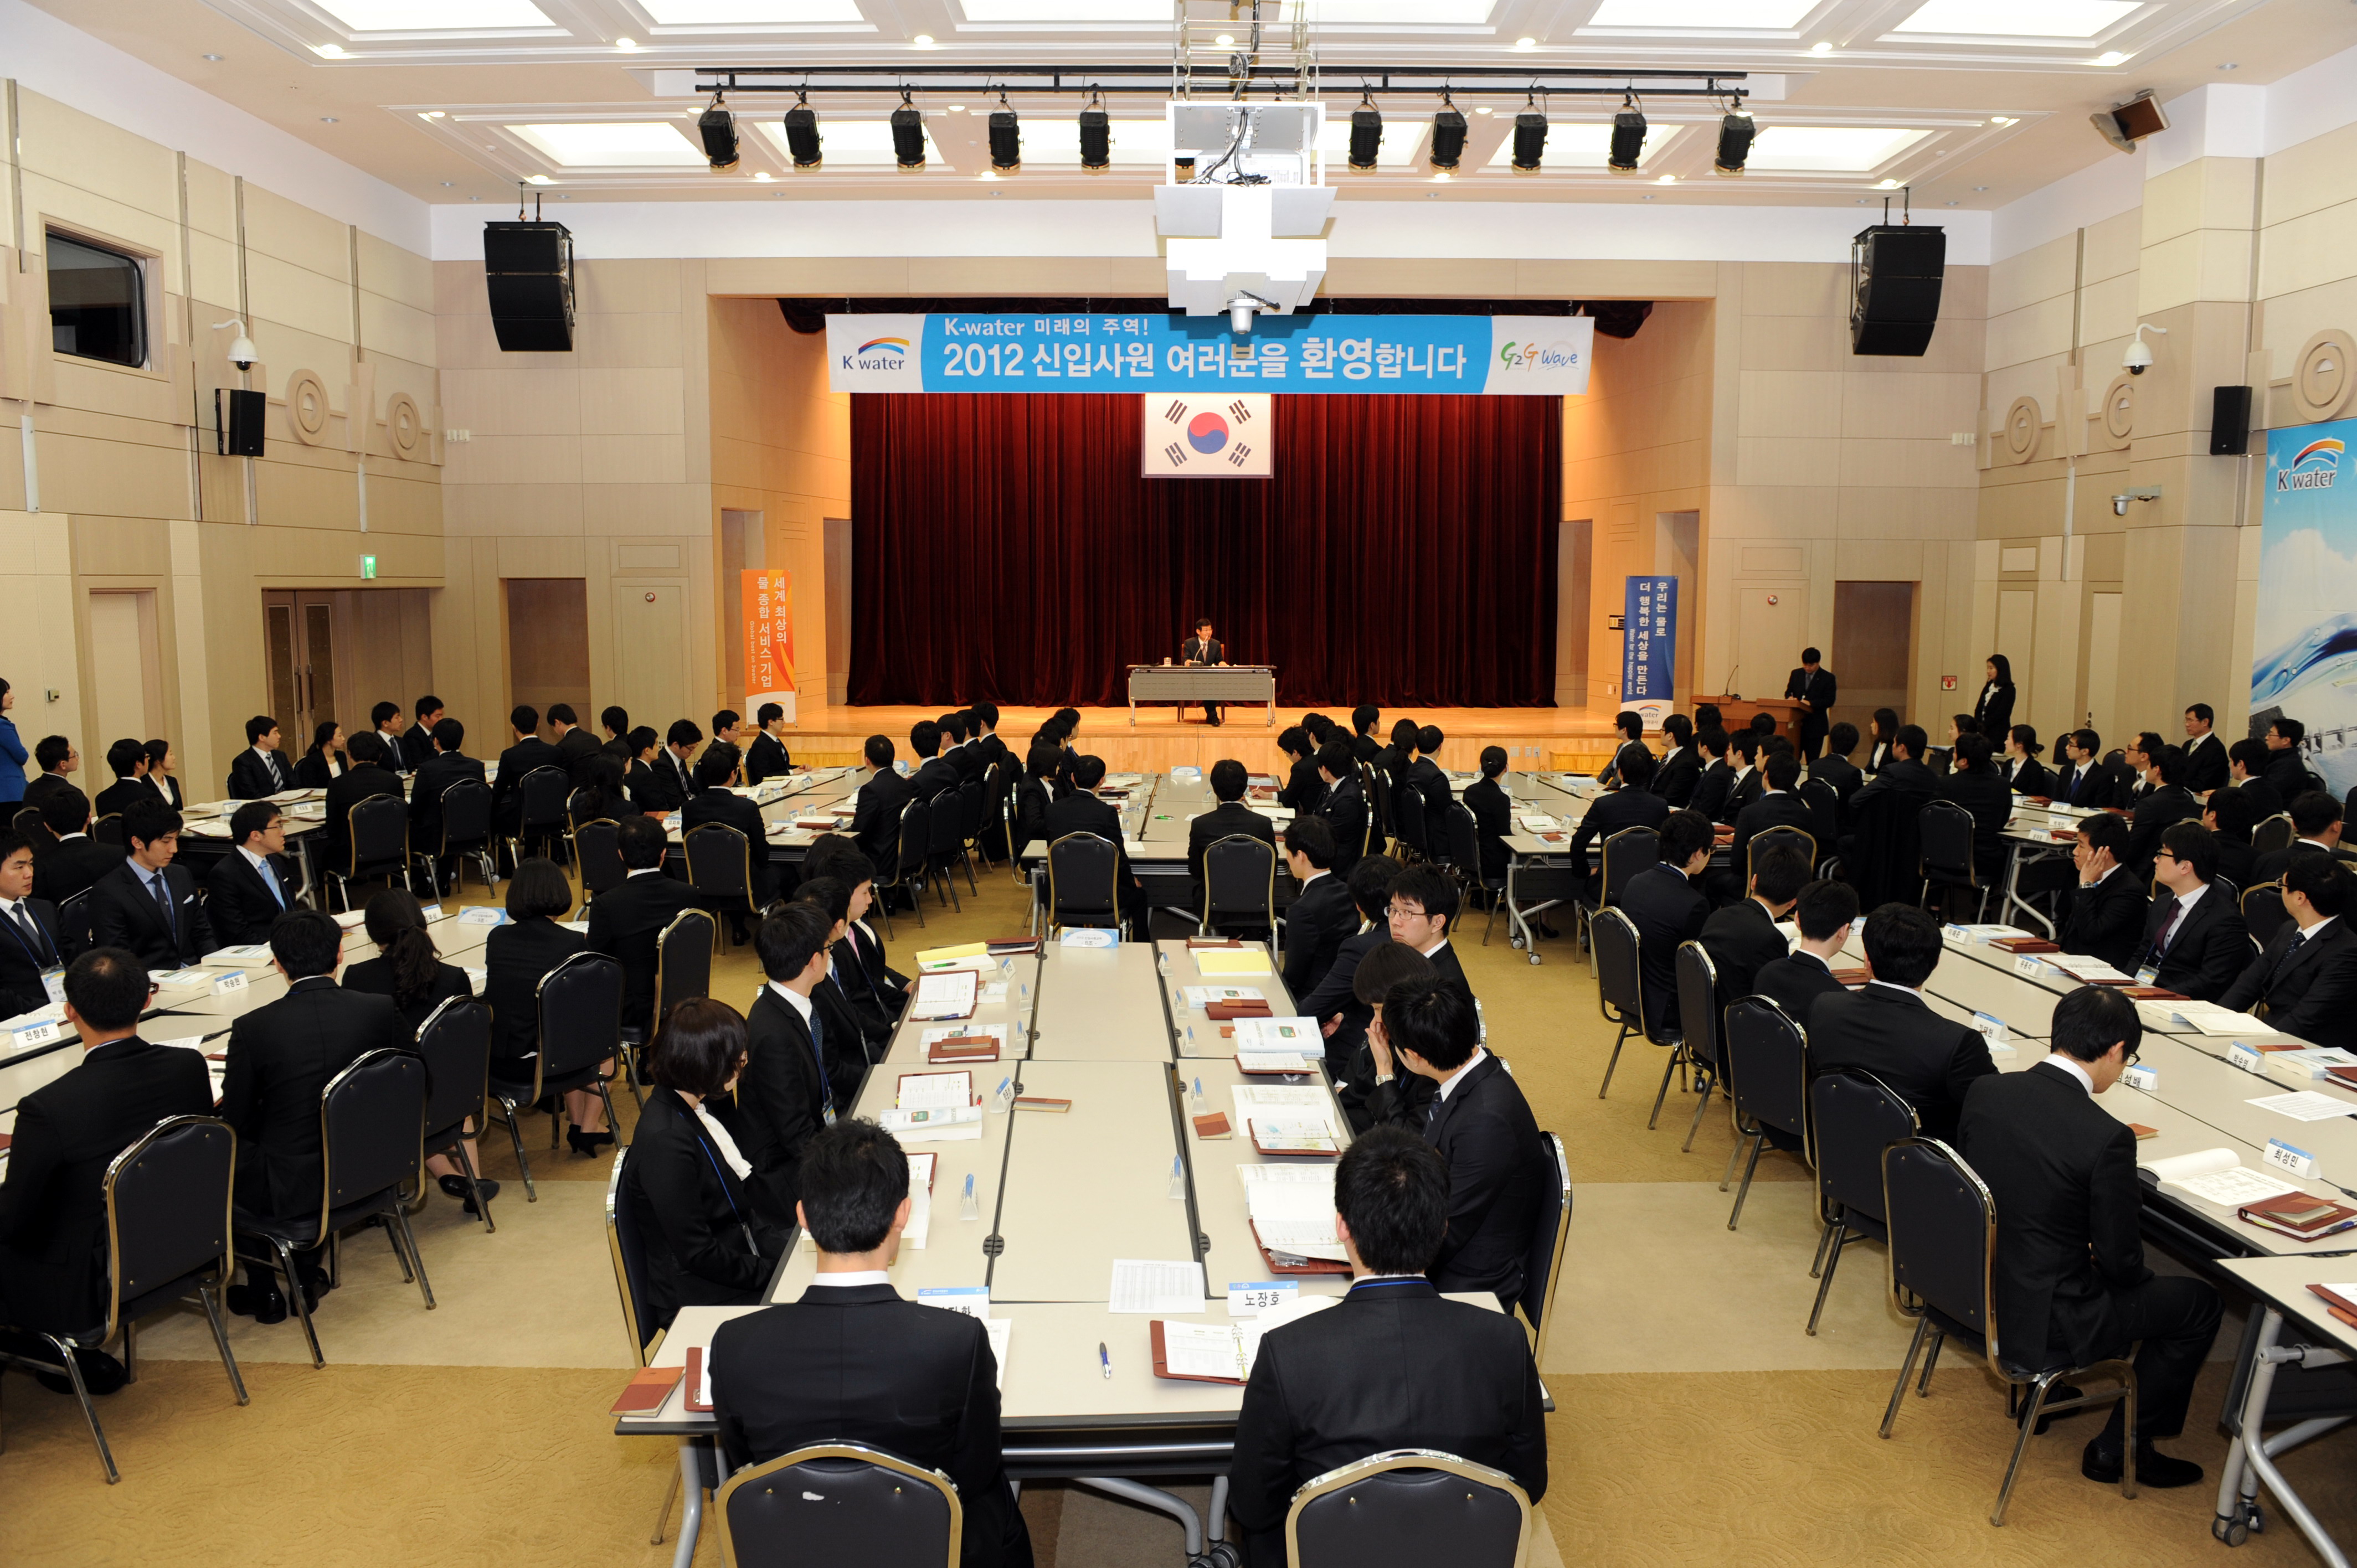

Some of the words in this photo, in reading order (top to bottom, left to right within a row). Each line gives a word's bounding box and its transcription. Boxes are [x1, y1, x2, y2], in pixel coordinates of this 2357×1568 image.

[944, 318, 1025, 336] K-water
[1035, 318, 1090, 336] 미래의
[1102, 318, 1149, 336] 주역!
[858, 357, 904, 370] water
[943, 342, 1025, 376] 2012
[1032, 342, 1154, 378] 신입사원
[1167, 341, 1289, 378] 여러분을
[1300, 337, 1466, 380] 환영합니다
[2292, 467, 2336, 489] water
[757, 576, 769, 590] 물
[774, 576, 786, 602] 세계
[1639, 582, 1650, 592] 더
[758, 593, 770, 619] 종합
[1656, 582, 1668, 613] 우리는
[775, 605, 787, 643] 최상의
[1639, 596, 1650, 627] 행복한
[1655, 616, 1667, 637] 물로
[759, 622, 771, 658] 서비스
[1637, 630, 1649, 661] 세상을
[760, 662, 772, 688] 기업
[1636, 665, 1648, 695] 만든다
[24, 1027, 49, 1041] 전창현
[2274, 1149, 2299, 1168] 최성민
[1245, 1291, 1280, 1308] 노장호
